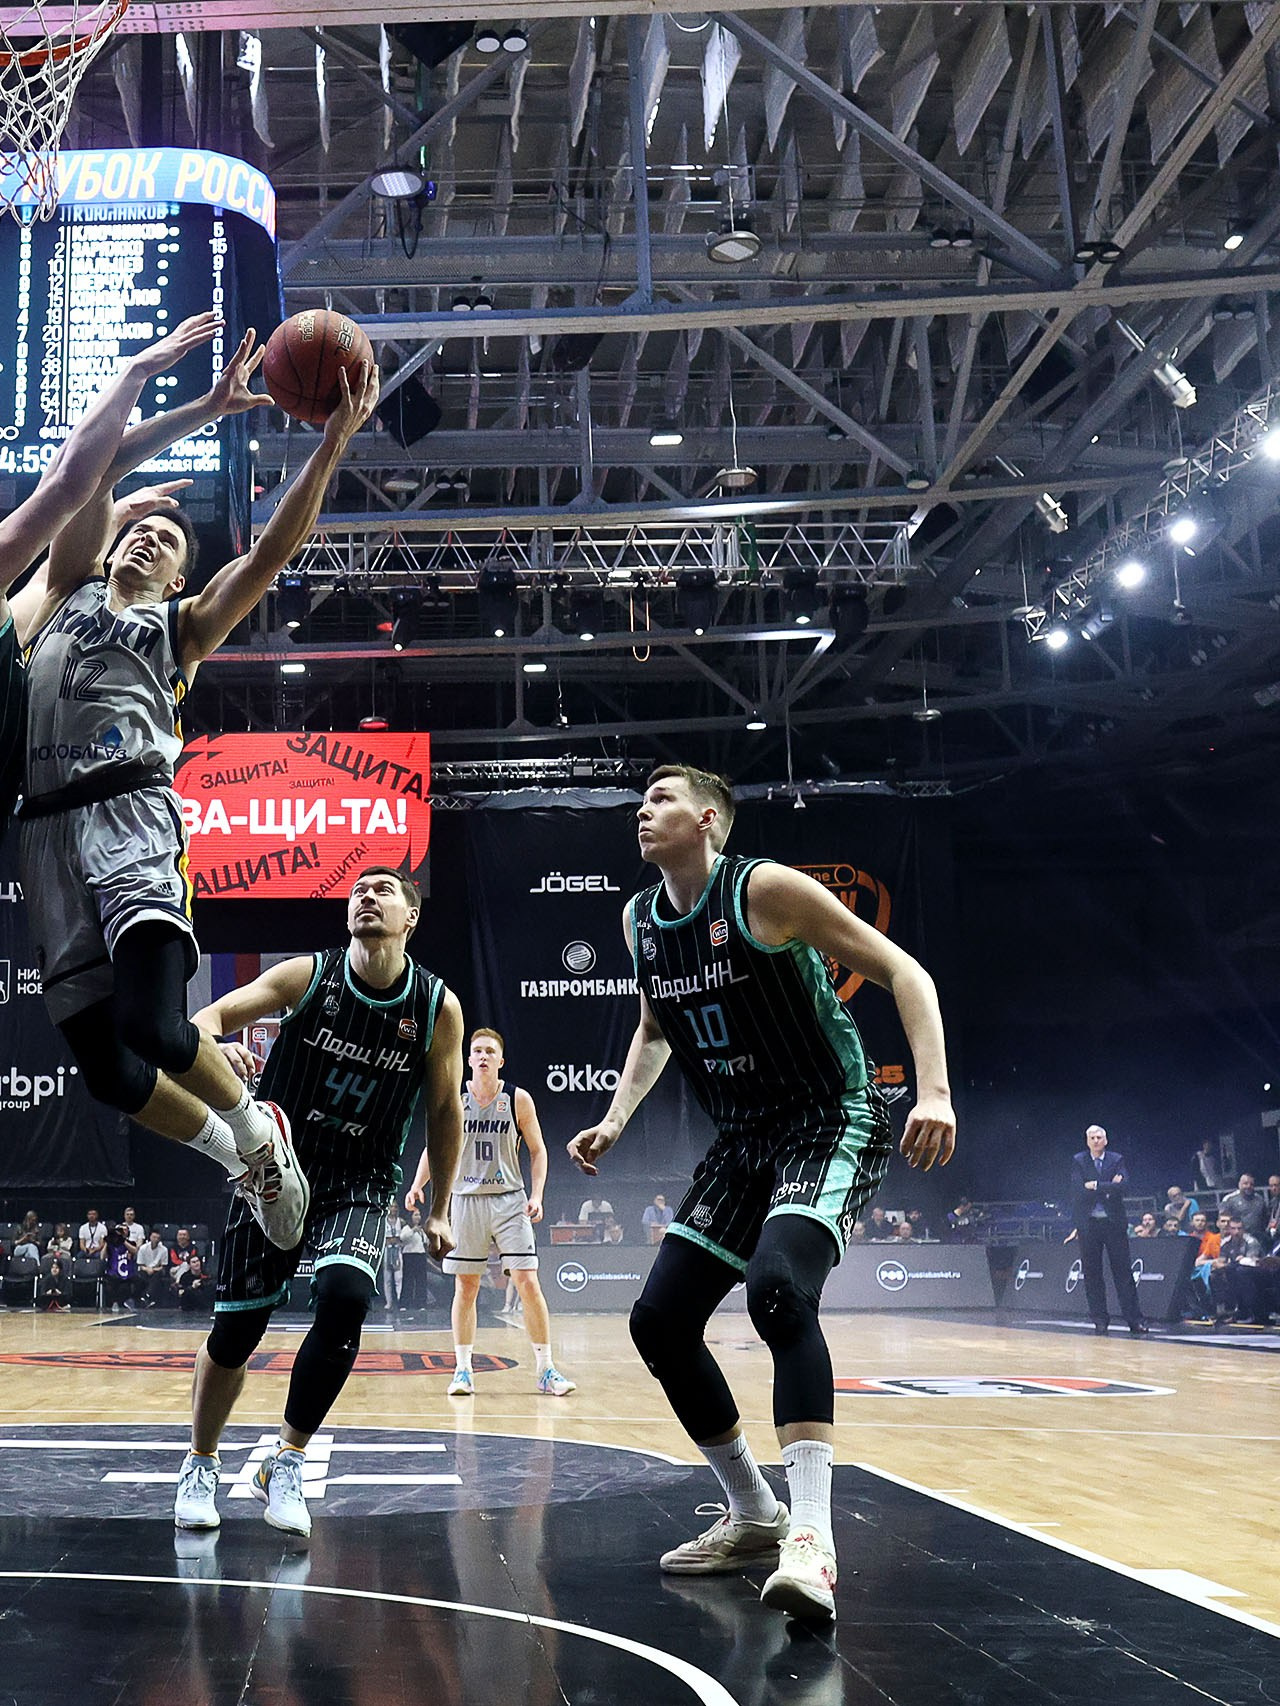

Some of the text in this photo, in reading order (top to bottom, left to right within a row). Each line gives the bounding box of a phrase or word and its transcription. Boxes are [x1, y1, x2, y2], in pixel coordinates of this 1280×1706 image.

[58, 226, 65, 241] 1
[55, 242, 65, 258] 2
[48, 258, 65, 275] 10
[48, 275, 64, 291] 12
[47, 291, 63, 307] 15
[213, 287, 224, 303] 0
[17, 309, 29, 325] 4
[17, 326, 28, 342] 7
[42, 324, 62, 341] 20
[45, 341, 61, 358] 21
[41, 357, 61, 375] 38
[40, 374, 60, 391] 44
[40, 391, 60, 408] 54
[44, 408, 59, 425] 71
[59, 656, 108, 701] 12
[200, 758, 289, 790] ЗАЩИТА!
[289, 777, 336, 789] ЗАЩИТА!
[182, 798, 407, 841] ЗА-ЩИ-ТА!
[194, 842, 320, 899] АЩИТА!
[530, 871, 620, 893] JÖGEL
[521, 979, 639, 998] ГАЗПРОМБАНК
[683, 1003, 730, 1048] 10
[325, 1067, 377, 1113] 44
[475, 1141, 493, 1161] 10
